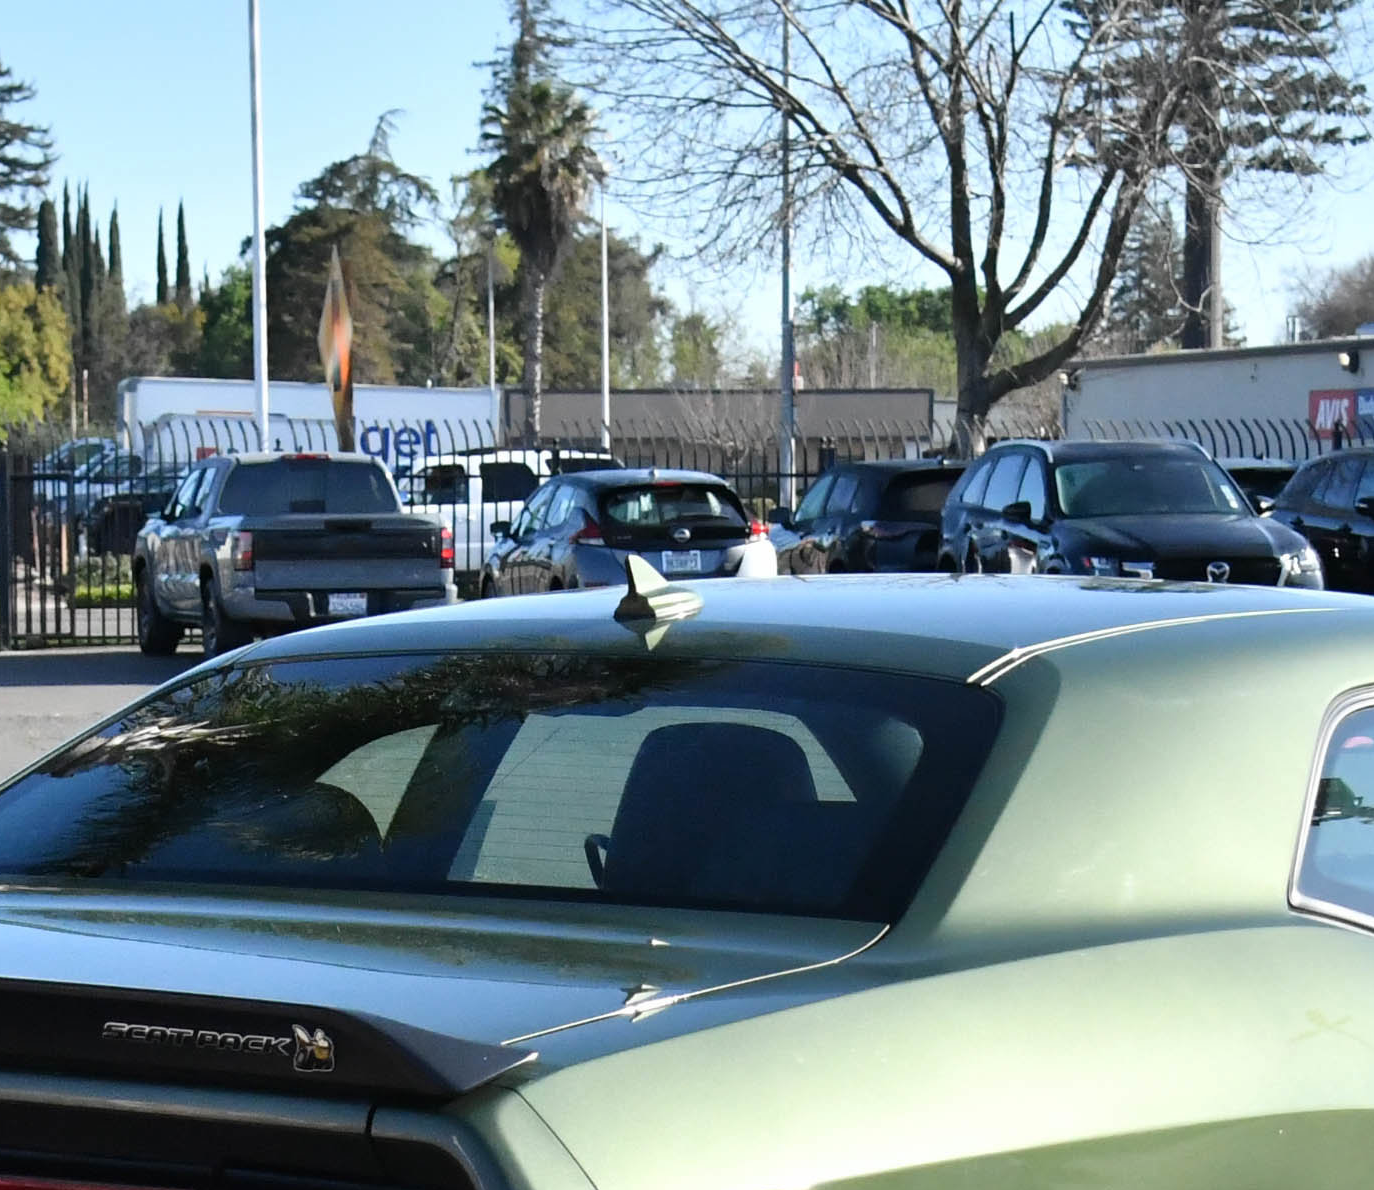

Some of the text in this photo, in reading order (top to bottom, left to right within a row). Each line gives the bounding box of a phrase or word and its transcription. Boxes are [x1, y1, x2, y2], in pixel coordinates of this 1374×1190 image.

[1315, 397, 1350, 430] AVIS
[102, 1021, 293, 1056] SCAT PACK
